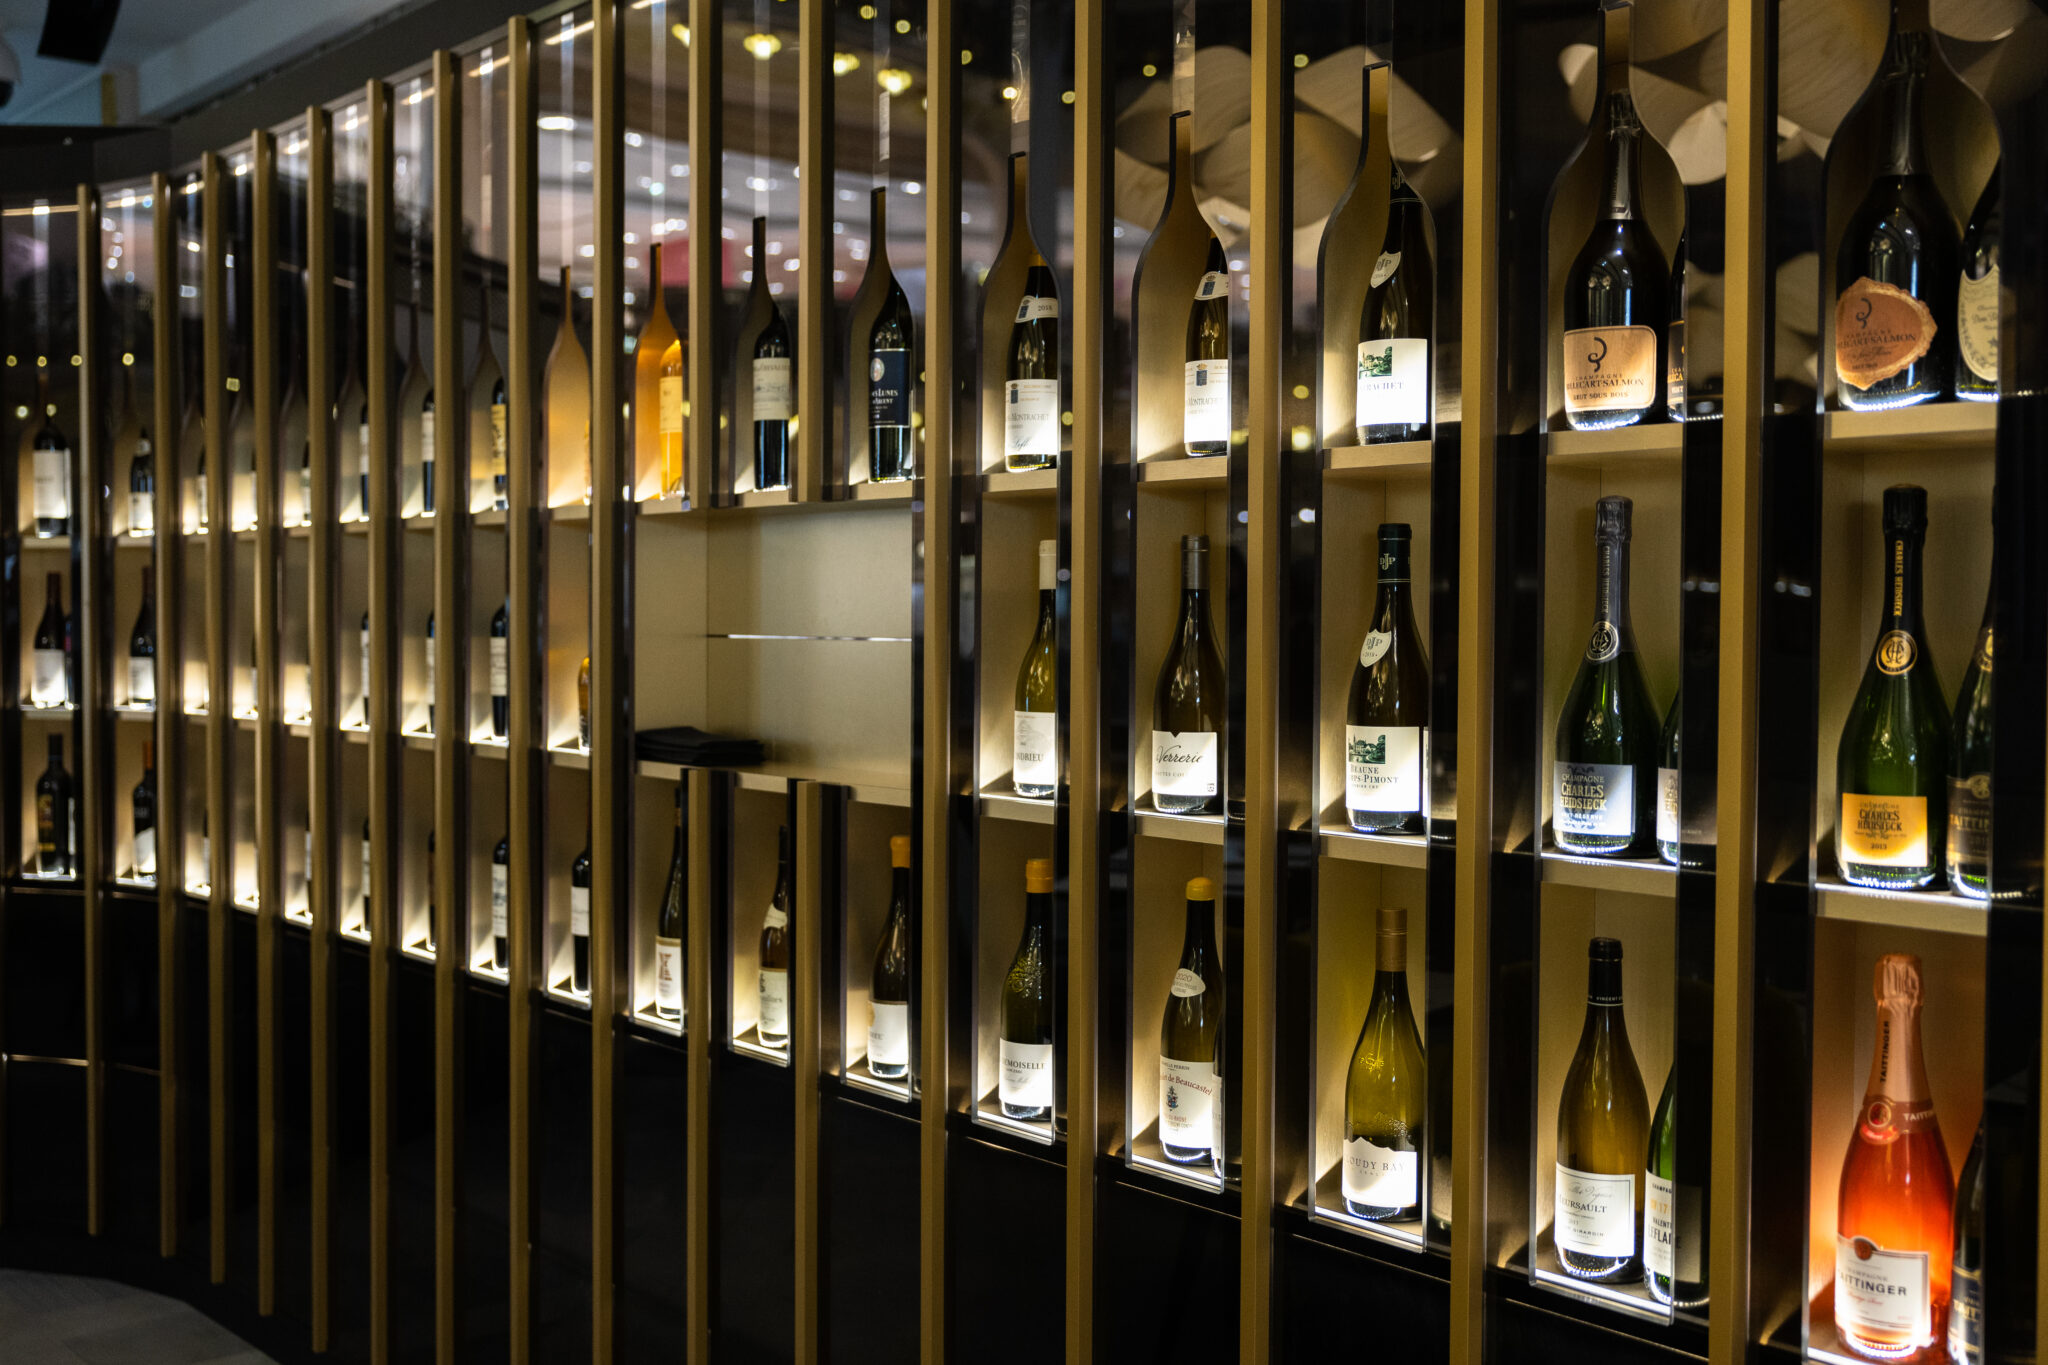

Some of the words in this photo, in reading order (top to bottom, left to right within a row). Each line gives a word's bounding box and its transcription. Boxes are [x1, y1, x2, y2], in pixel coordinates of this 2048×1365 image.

[1589, 392, 1607, 400] SOUS
[1015, 752, 1044, 762] NDRIEU
[1561, 773, 1605, 783] CHAMPAGNE
[1561, 782, 1604, 798] CHARLES
[1859, 808, 1901, 821] CHARLES
[1879, 1020, 1890, 1083] TAITTINGER
[1175, 1075, 1213, 1096] Beaucastel
[1347, 1156, 1377, 1170] OUDY
[1559, 1196, 1608, 1213] URSAULT
[1838, 1270, 1907, 1297] AITTINGER
